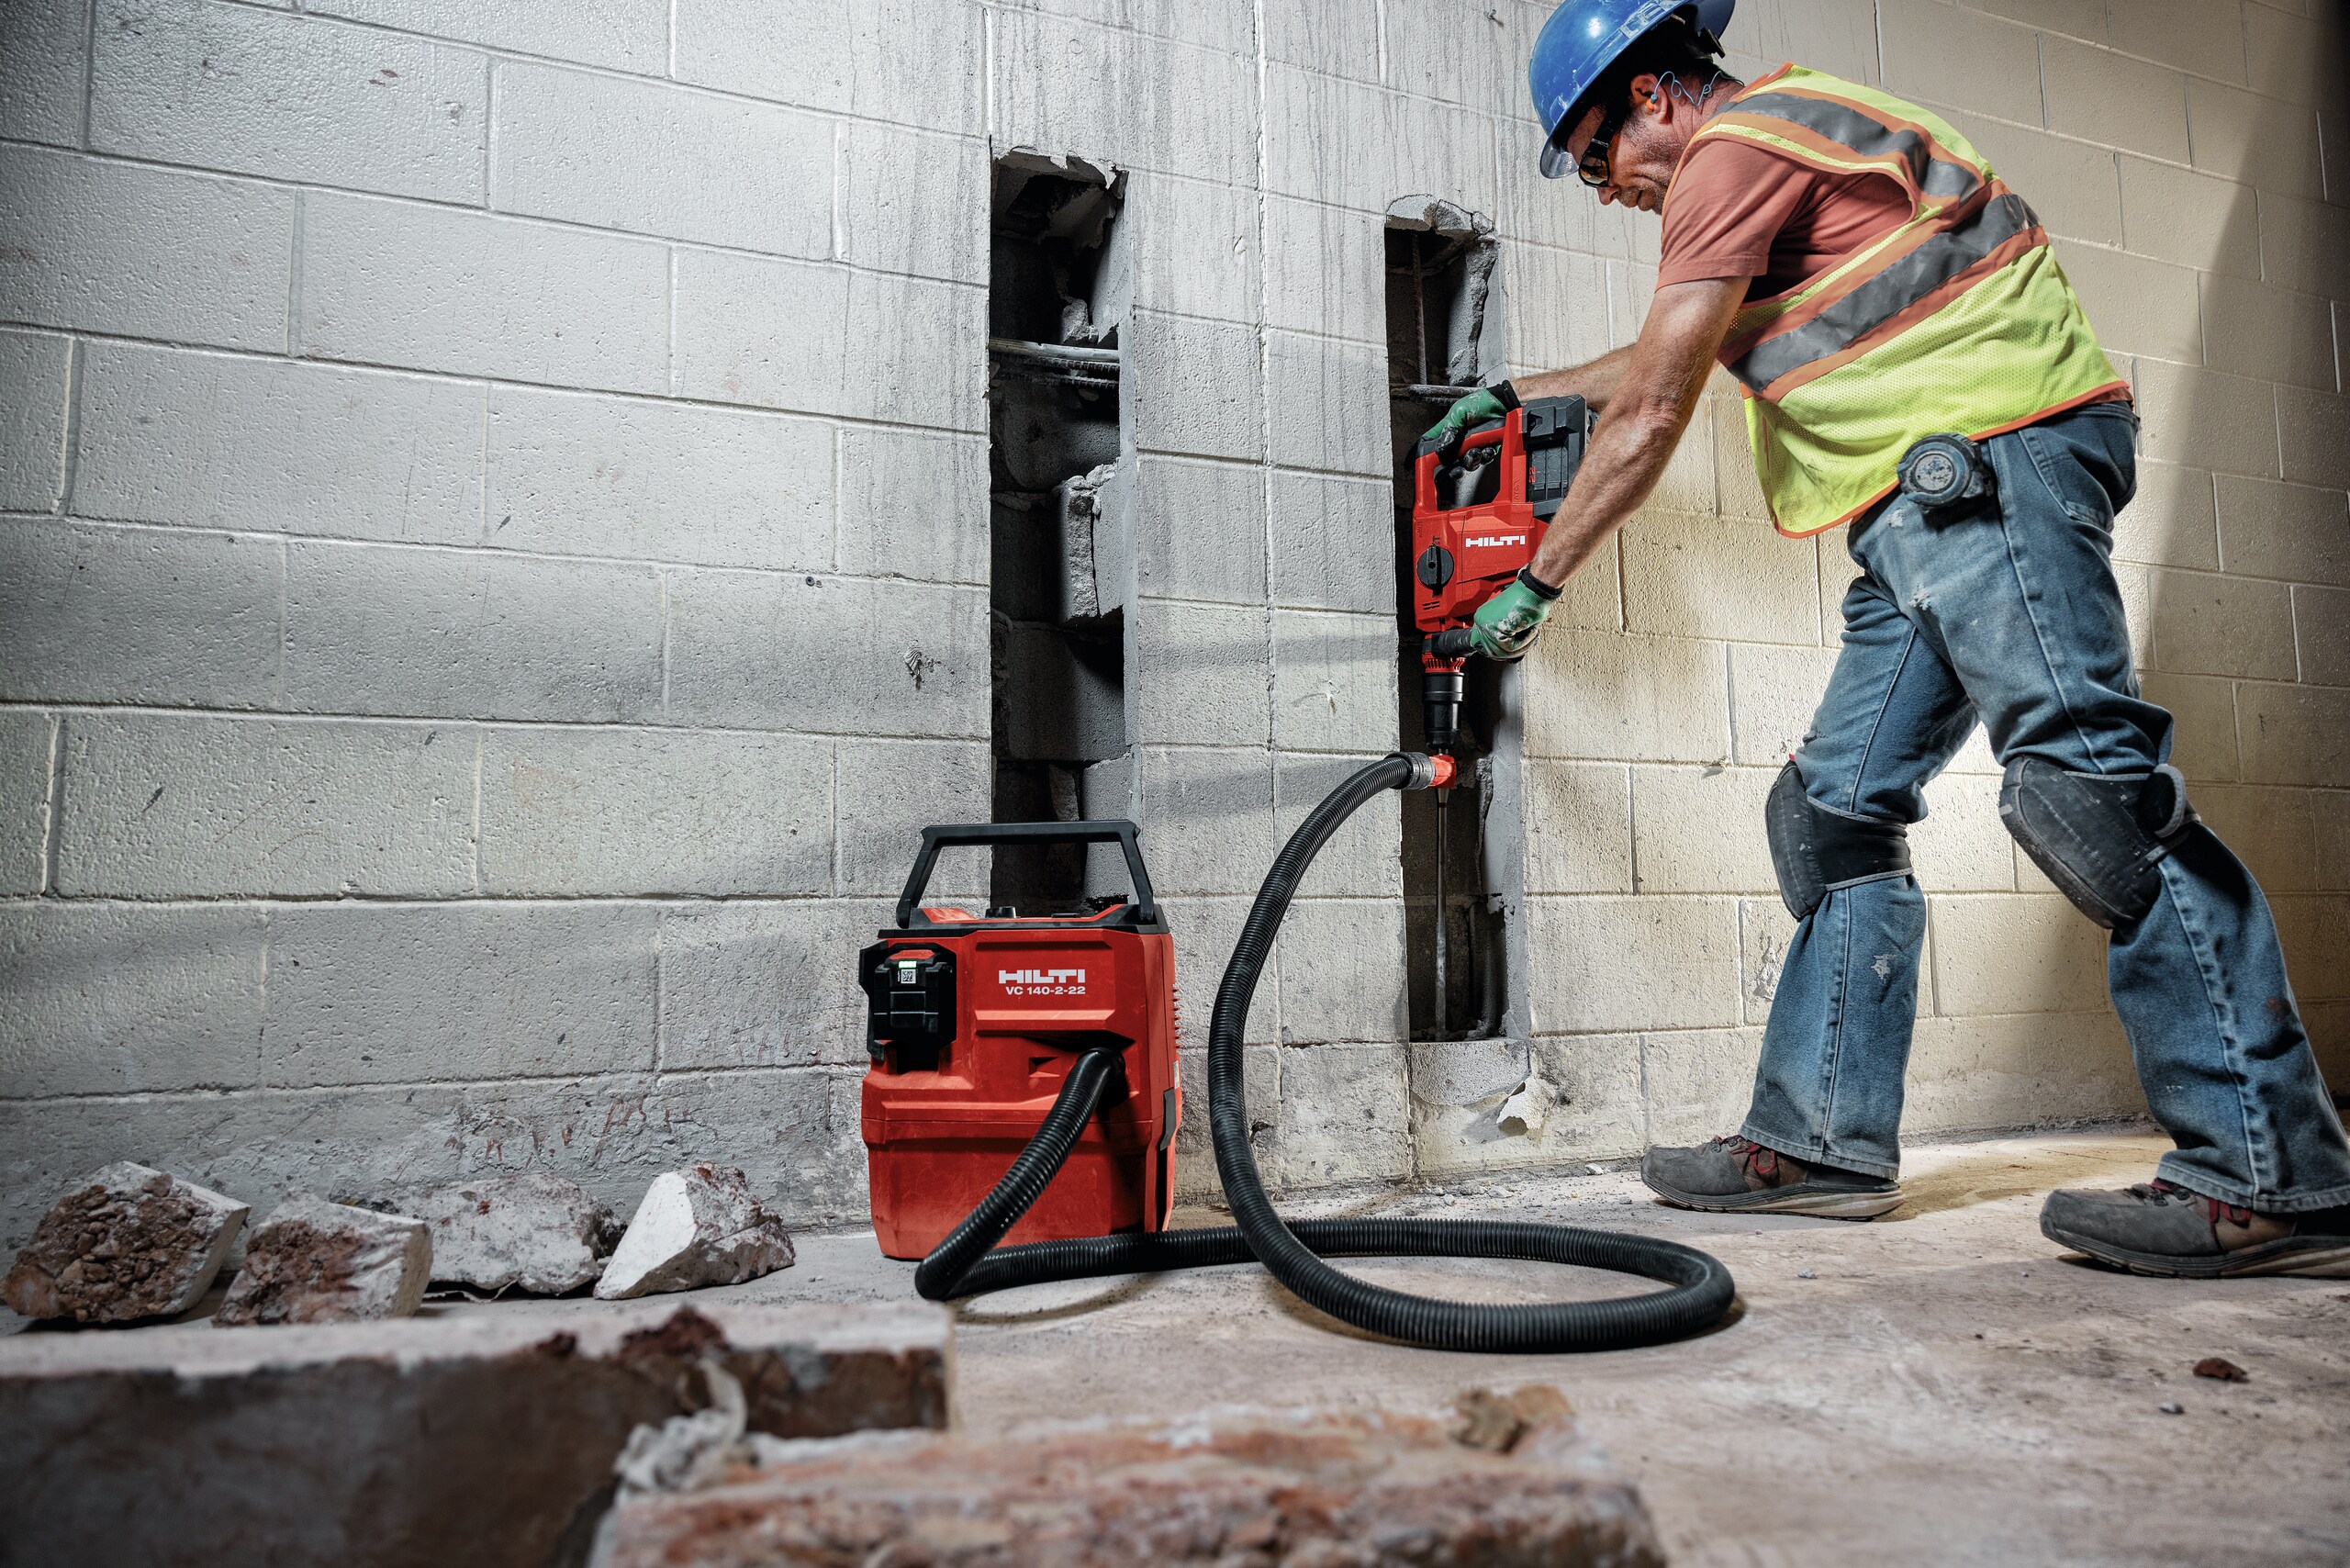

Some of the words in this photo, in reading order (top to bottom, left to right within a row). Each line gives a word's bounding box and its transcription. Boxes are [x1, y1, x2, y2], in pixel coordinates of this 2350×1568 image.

[1528, 466, 1536, 483] 22
[1465, 535, 1526, 548] HILTI
[998, 969, 1086, 984] HILTI
[1005, 986, 1024, 995] VC
[1026, 986, 1086, 995] 140-2-22
